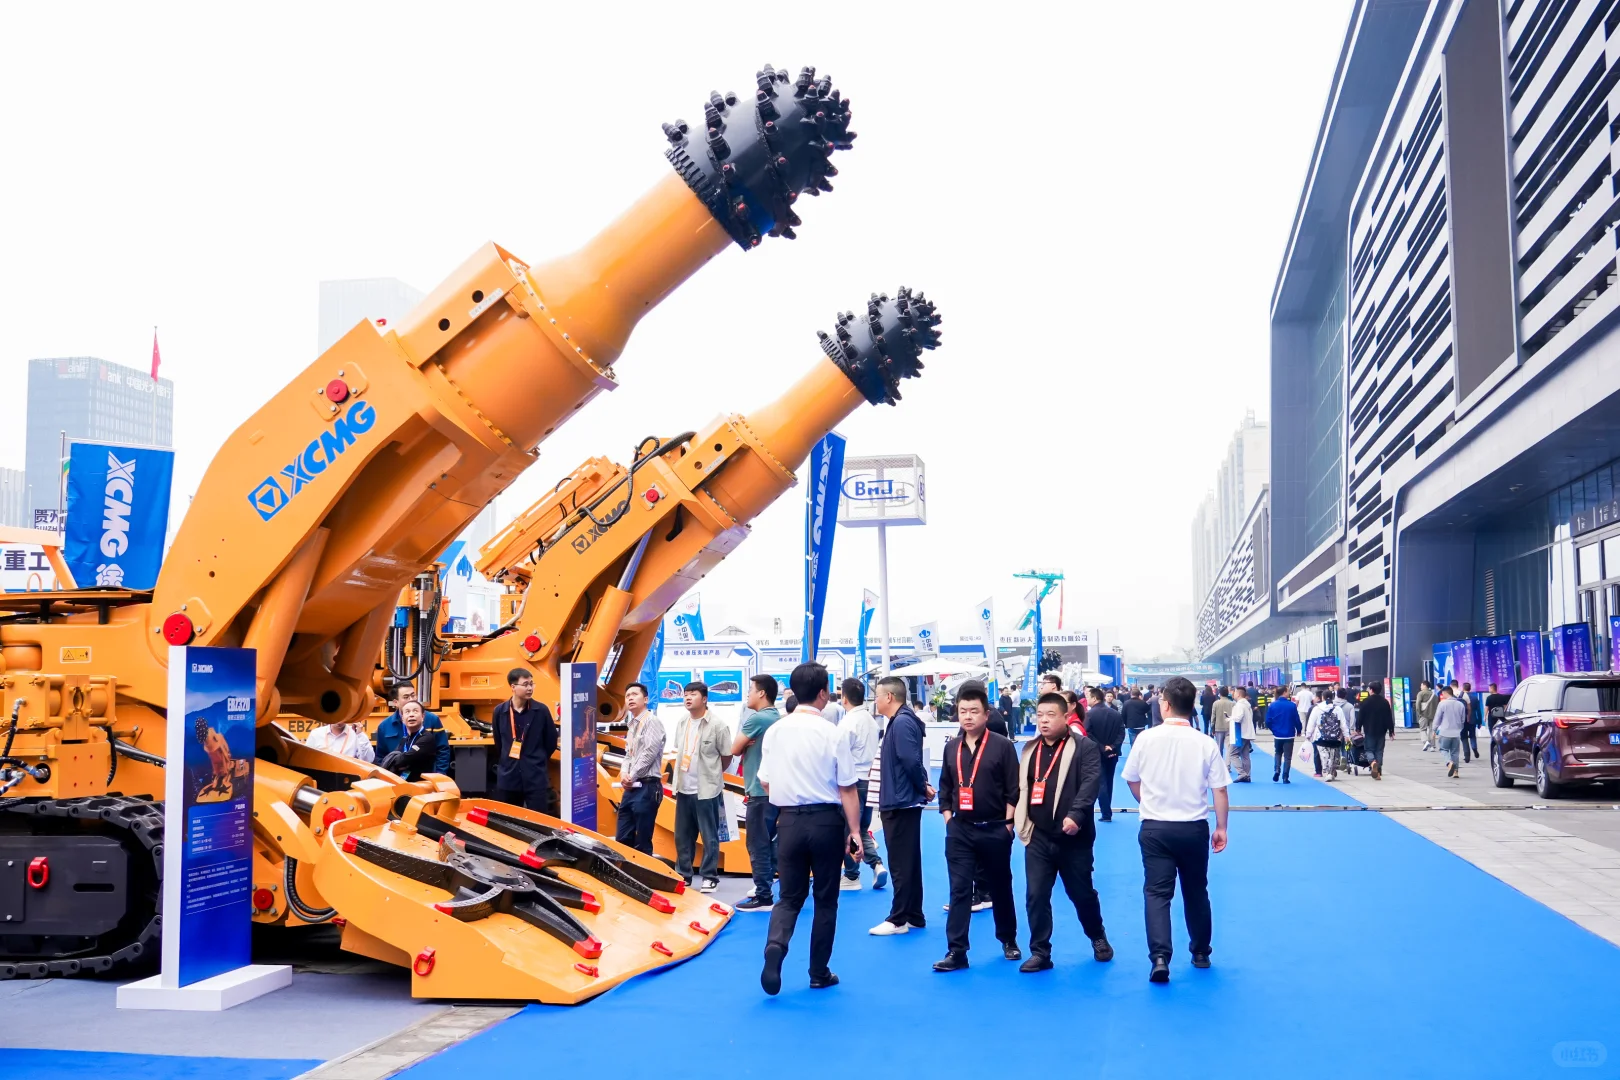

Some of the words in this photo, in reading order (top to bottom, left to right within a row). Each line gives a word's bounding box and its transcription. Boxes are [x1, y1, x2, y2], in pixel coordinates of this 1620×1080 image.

[280, 400, 377, 499] XCMG
[100, 450, 136, 558] XCMG
[0, 549, 51, 571] 重工
[228, 697, 250, 712] EBZ320
